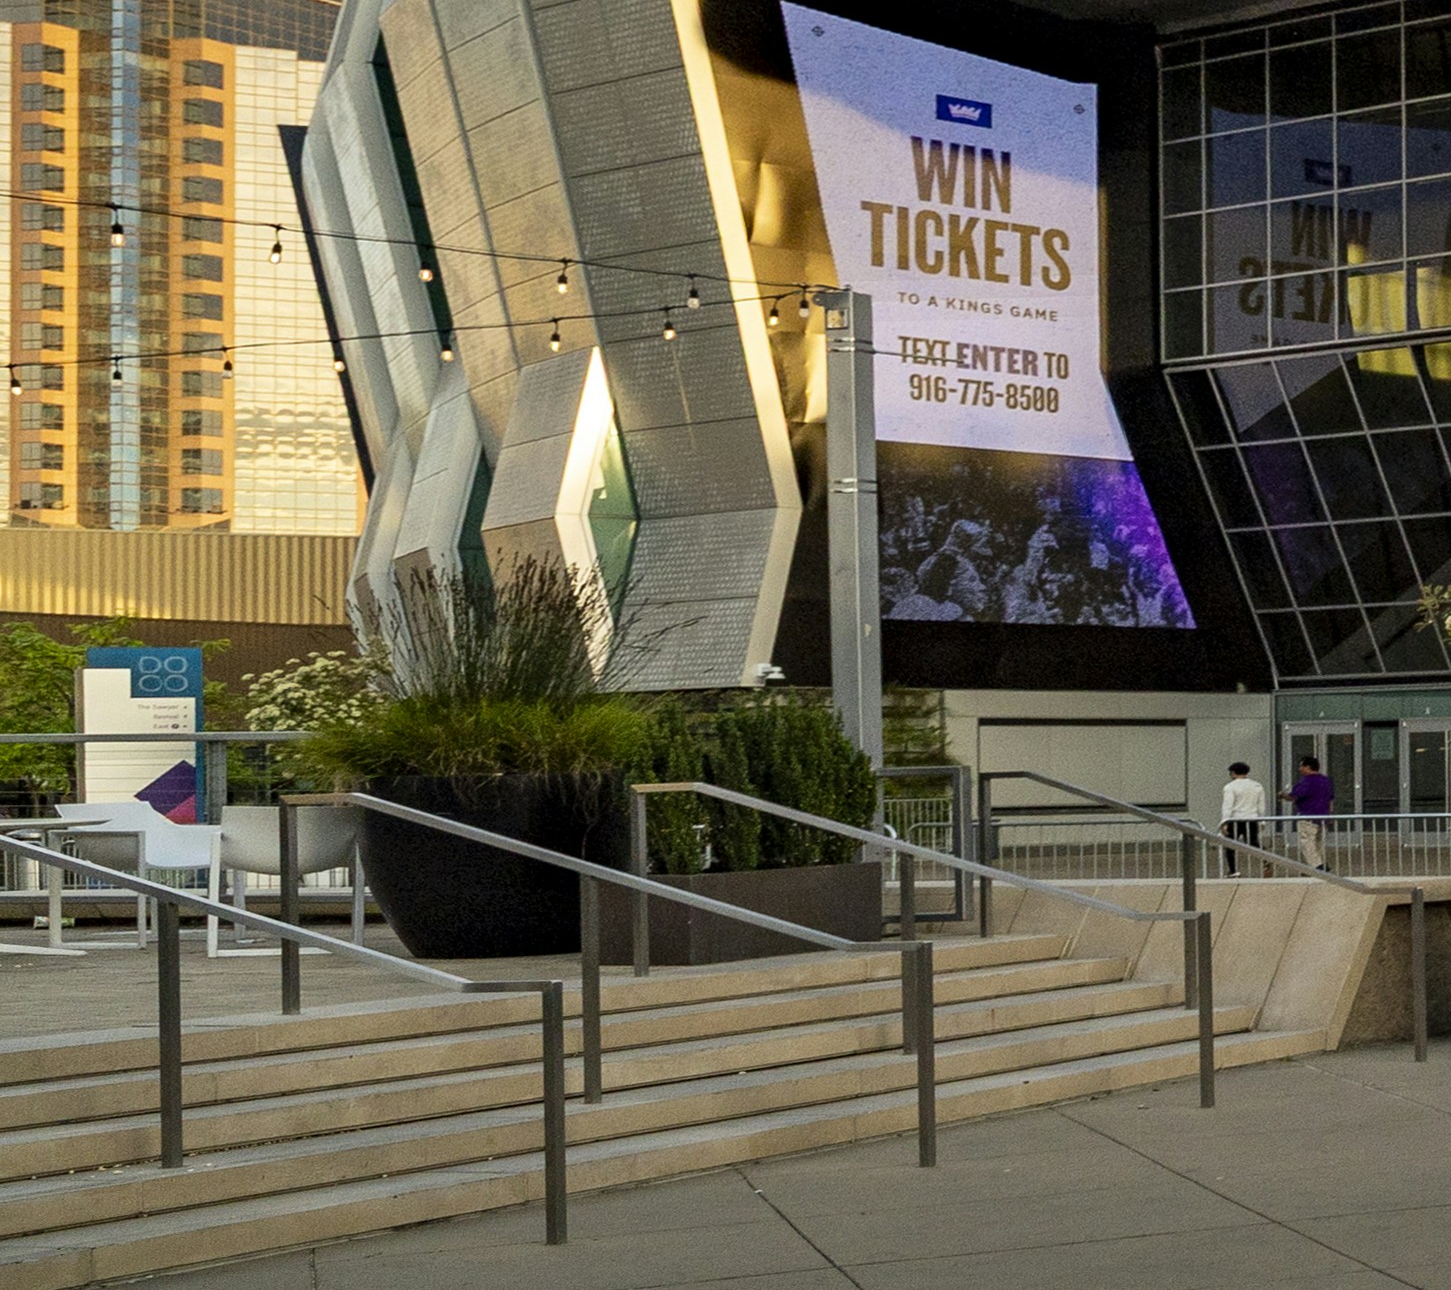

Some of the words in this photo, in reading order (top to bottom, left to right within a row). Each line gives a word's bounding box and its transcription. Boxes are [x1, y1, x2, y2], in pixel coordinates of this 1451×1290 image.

[910, 136, 1011, 214] WIN
[861, 200, 1071, 291] TICKETS
[897, 291, 920, 305] TO
[927, 296, 939, 307] A
[946, 297, 1003, 315] KINGS
[1010, 306, 1059, 322] GAME
[897, 335, 951, 367] TEXT
[956, 342, 1039, 377] ENTER
[1043, 351, 1070, 380] TO
[909, 373, 1060, 413] 916-775-8500
